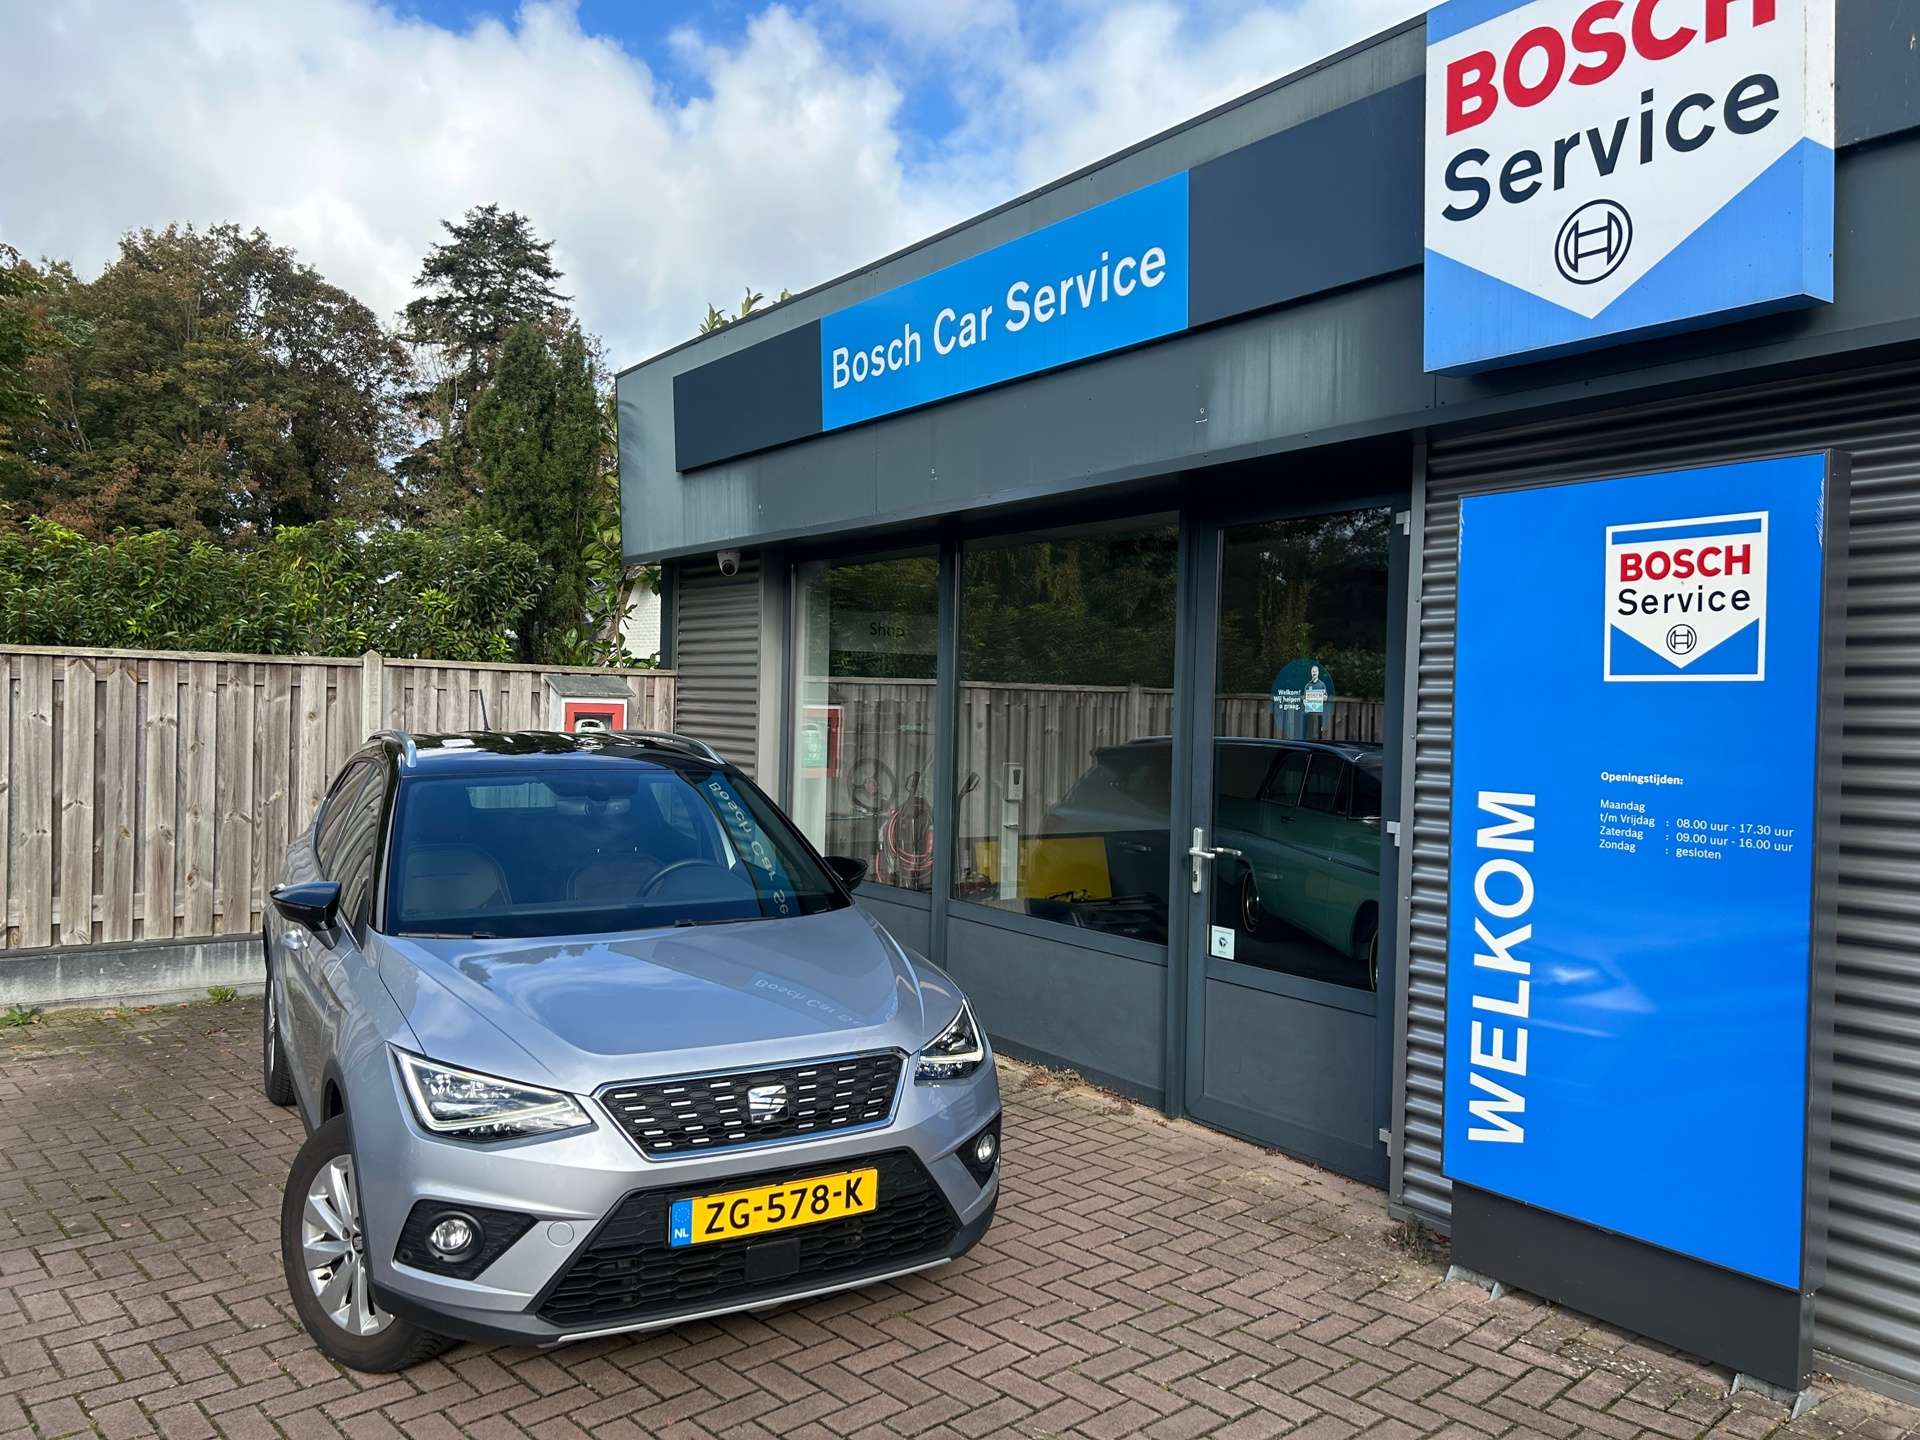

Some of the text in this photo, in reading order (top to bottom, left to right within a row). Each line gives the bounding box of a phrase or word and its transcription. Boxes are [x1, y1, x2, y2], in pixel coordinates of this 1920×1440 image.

[1441, 73, 1780, 222] Service
[832, 246, 1167, 390] Bosch Car Service
[1620, 544, 1751, 582] BOSCH
[1617, 585, 1751, 616] Service
[1600, 771, 1684, 786] Openingstijden:
[1600, 799, 1646, 813] Maandag
[1599, 825, 1645, 840] Zaterdag
[1675, 832, 1708, 844] 09.00
[1710, 837, 1729, 846] uur
[1739, 838, 1772, 850] 16.00
[1774, 842, 1794, 852] uur
[1600, 812, 1618, 823] t/m
[1620, 814, 1656, 828] Vrijdag
[1676, 818, 1708, 830] 08.00
[1710, 823, 1729, 832] uur
[1739, 823, 1772, 836] 17.30
[1774, 828, 1795, 838] uur
[1599, 838, 1637, 853] Zondag
[1675, 847, 1722, 860] gesloten
[1467, 790, 1536, 1144] WELKOM
[674, 1177, 864, 1239] NL ZG-578-K
